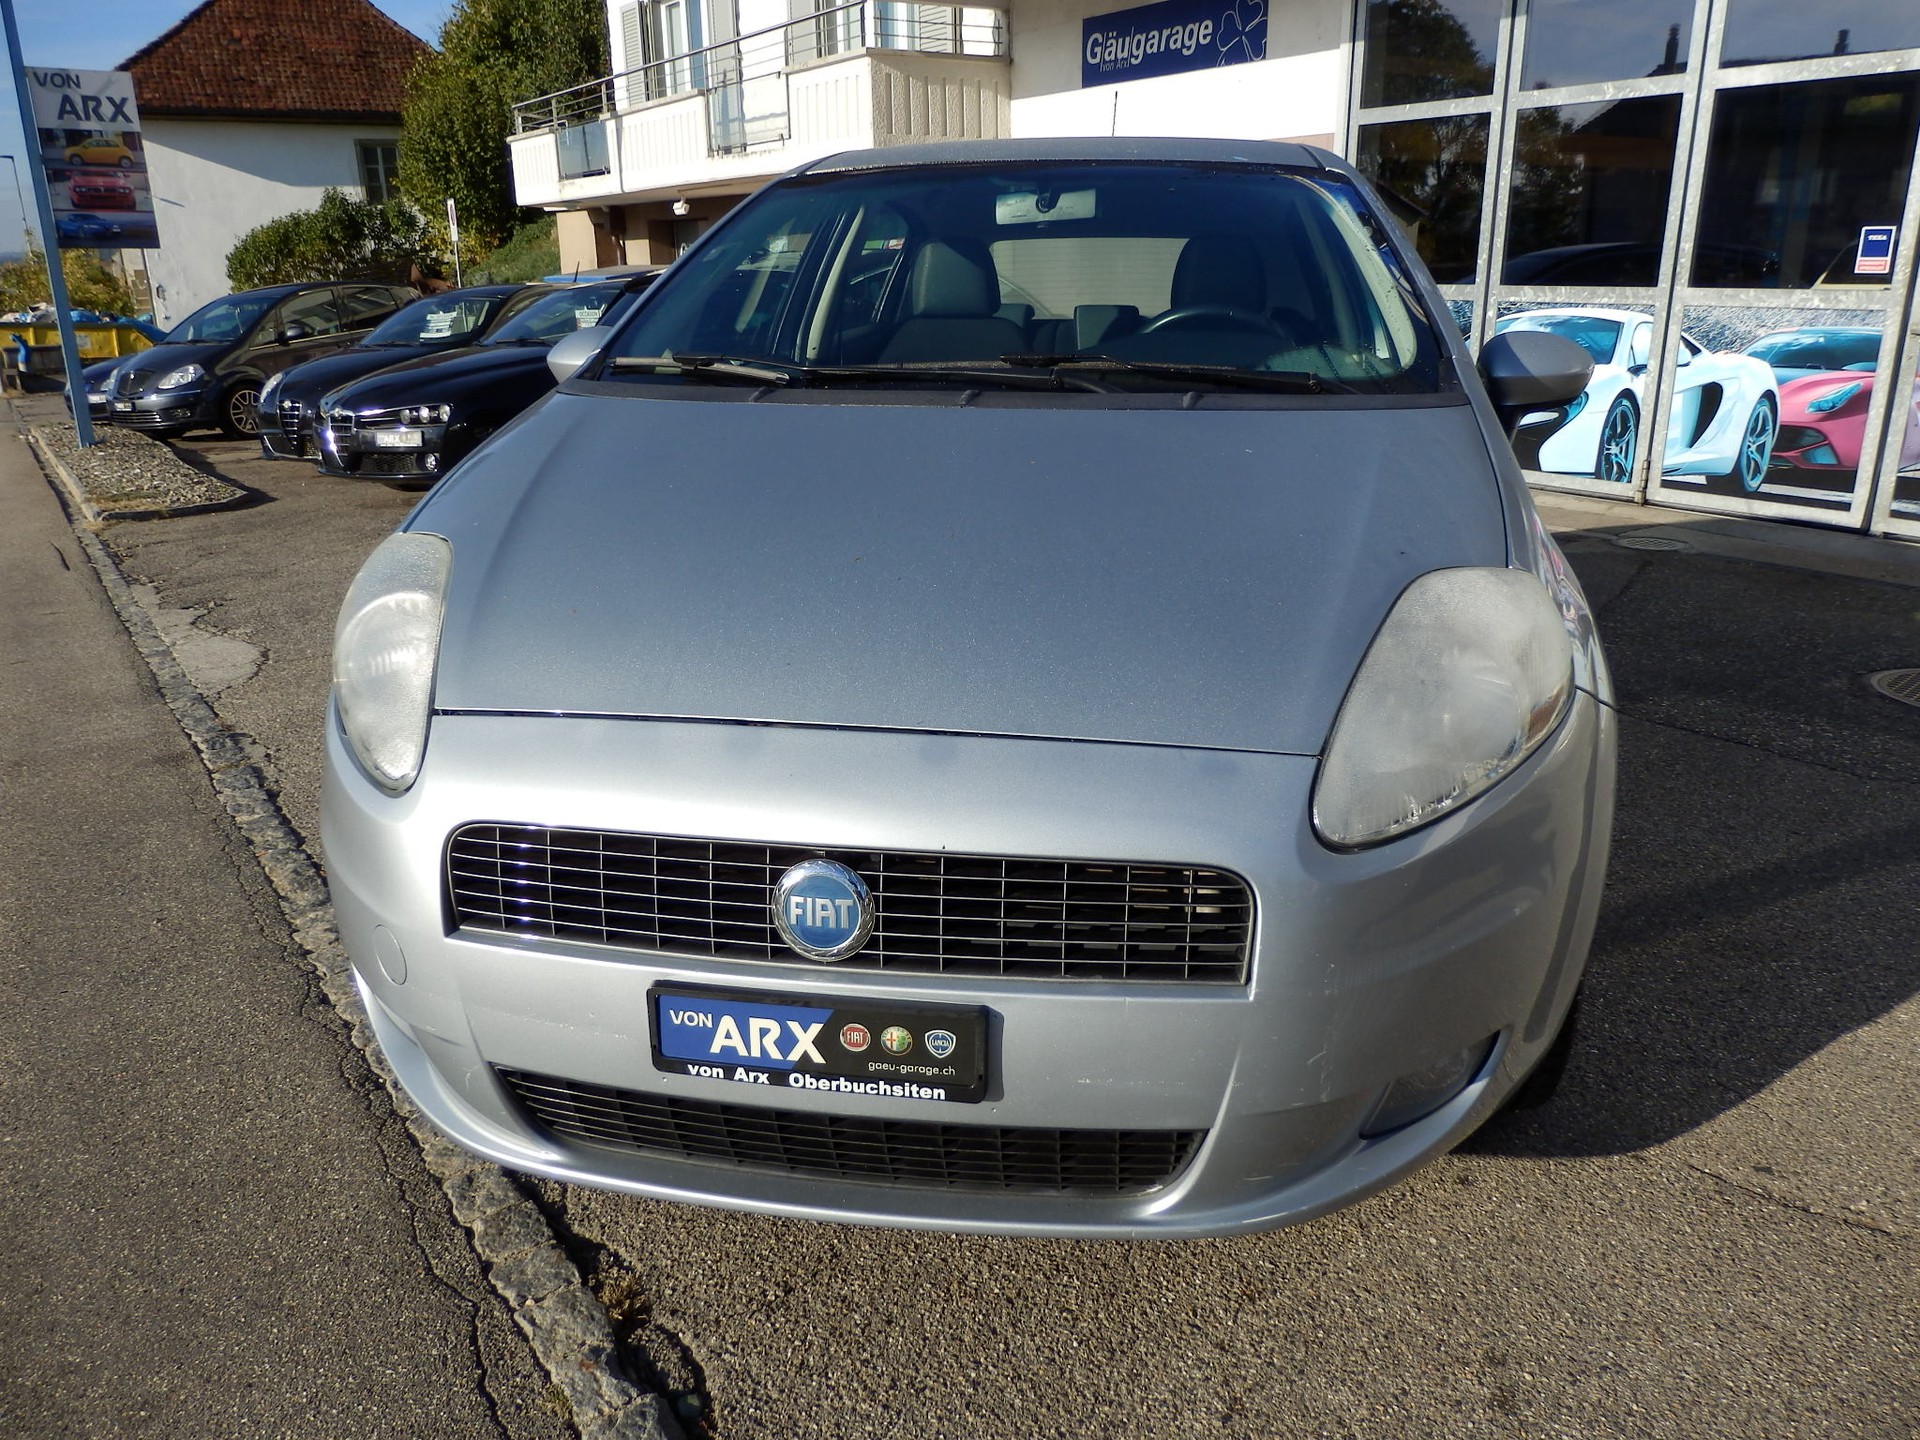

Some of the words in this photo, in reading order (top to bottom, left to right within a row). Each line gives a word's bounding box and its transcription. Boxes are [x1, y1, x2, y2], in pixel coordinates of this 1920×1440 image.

[1086, 19, 1213, 65] Gäugarage
[33, 71, 82, 89] VON
[57, 94, 134, 124] ARX
[789, 895, 854, 929] FIAT
[669, 1009, 713, 1028] VON
[709, 1014, 827, 1064] ARX
[846, 1031, 864, 1044] FIAT
[931, 1038, 950, 1047] LANCIA
[687, 1064, 725, 1079] von
[733, 1067, 770, 1085] Arx
[788, 1072, 946, 1100] Oberbuchsiten
[868, 1061, 956, 1076] gaeu-garage.ch
